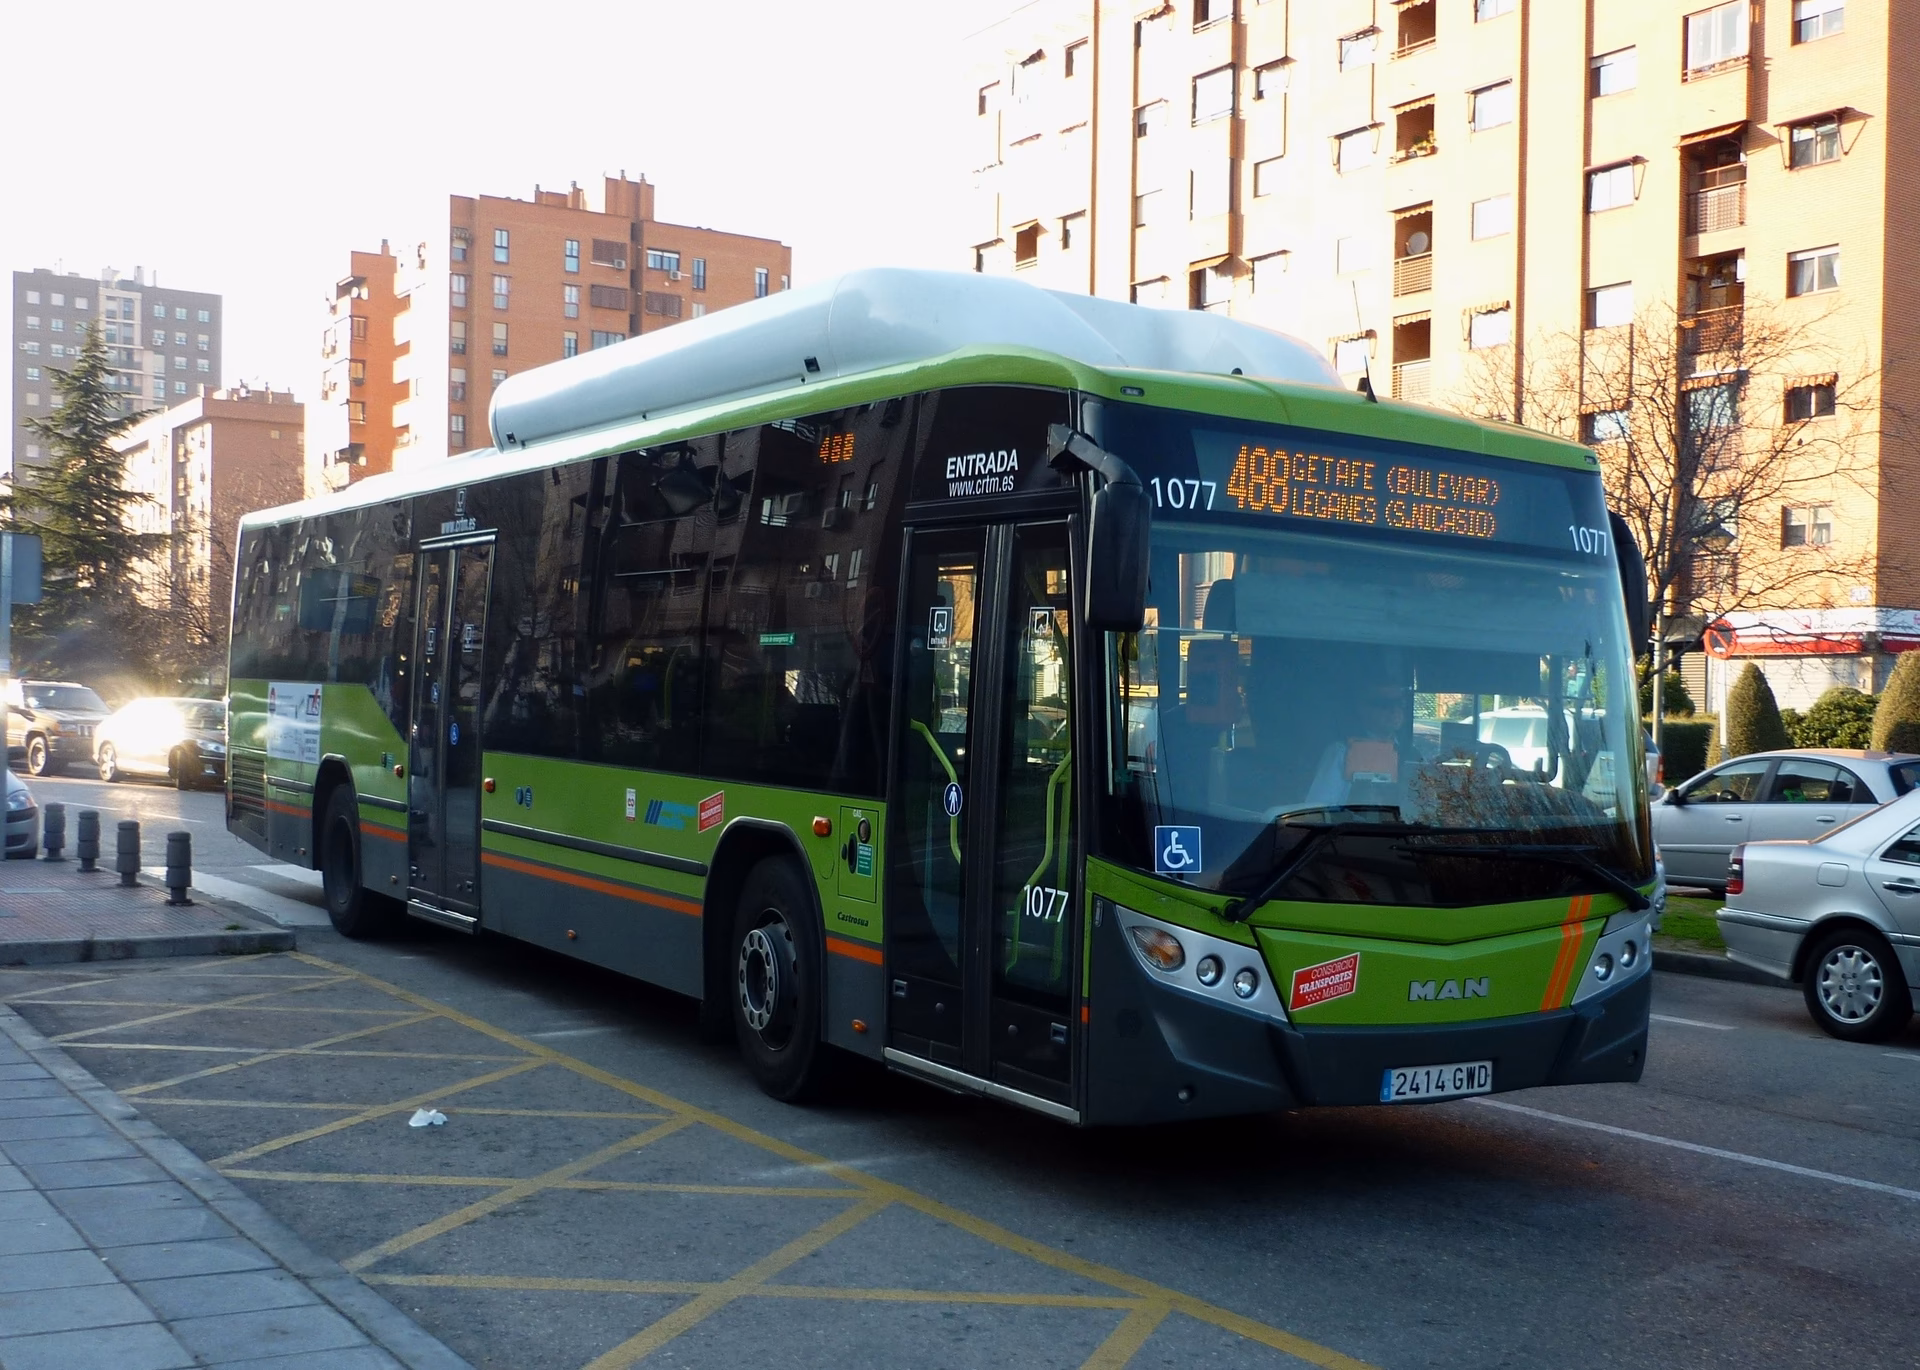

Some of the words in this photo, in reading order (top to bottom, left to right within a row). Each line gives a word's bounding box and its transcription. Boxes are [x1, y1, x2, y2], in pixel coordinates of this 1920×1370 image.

[819, 434, 854, 464] 488
[946, 448, 1019, 479] ENTRADA
[948, 474, 1014, 498] www.crtm.es
[1150, 477, 1217, 511] 1077
[1227, 445, 1289, 513] 488
[1292, 453, 1376, 490] GETAFE
[1387, 466, 1499, 506] (BULEVAR)
[1292, 487, 1377, 524] LEGANES
[1568, 525, 1607, 557] 1077
[837, 911, 869, 927] Castrosua
[1023, 884, 1069, 923] 1077
[1299, 969, 1353, 994] TRANSPORTES
[1311, 958, 1355, 979] CONSORCIO
[1321, 981, 1351, 998] MADRID
[1408, 976, 1489, 1001] MAN
[1395, 1069, 1446, 1096] 2414
[1453, 1064, 1488, 1090] GWD
